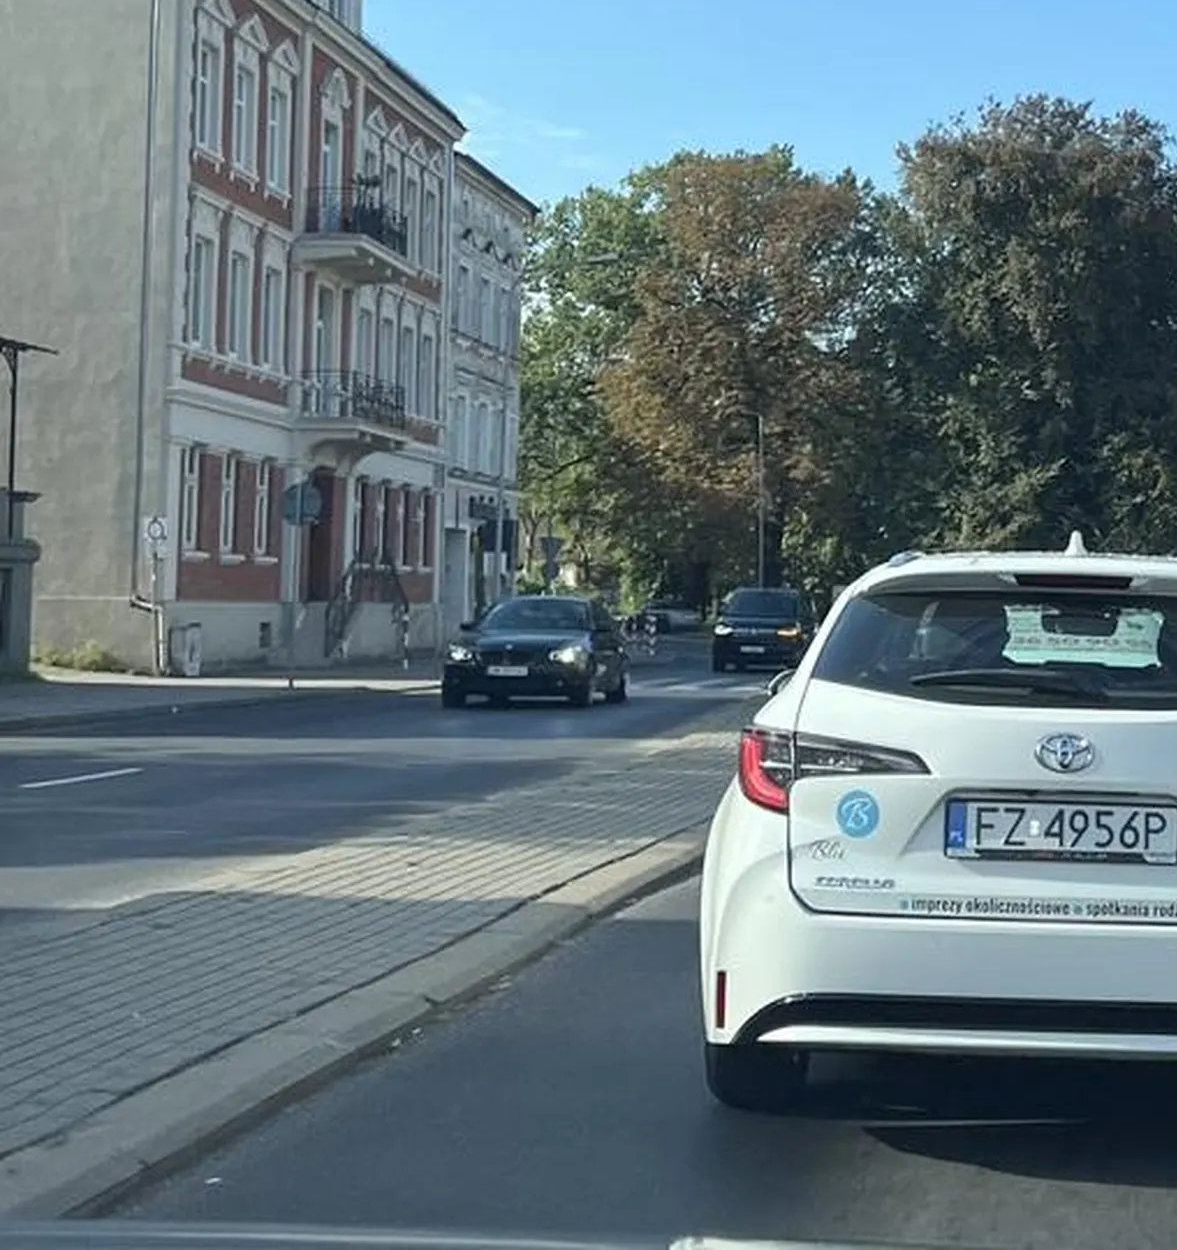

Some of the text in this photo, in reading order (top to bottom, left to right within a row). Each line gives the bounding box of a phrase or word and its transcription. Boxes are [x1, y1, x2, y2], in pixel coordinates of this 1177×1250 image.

[976, 806, 1167, 851] FZ 4956P
[911, 899, 964, 915] imprezy
[965, 898, 1070, 916] okolicznościowe
[1086, 901, 1150, 918] spotkania
